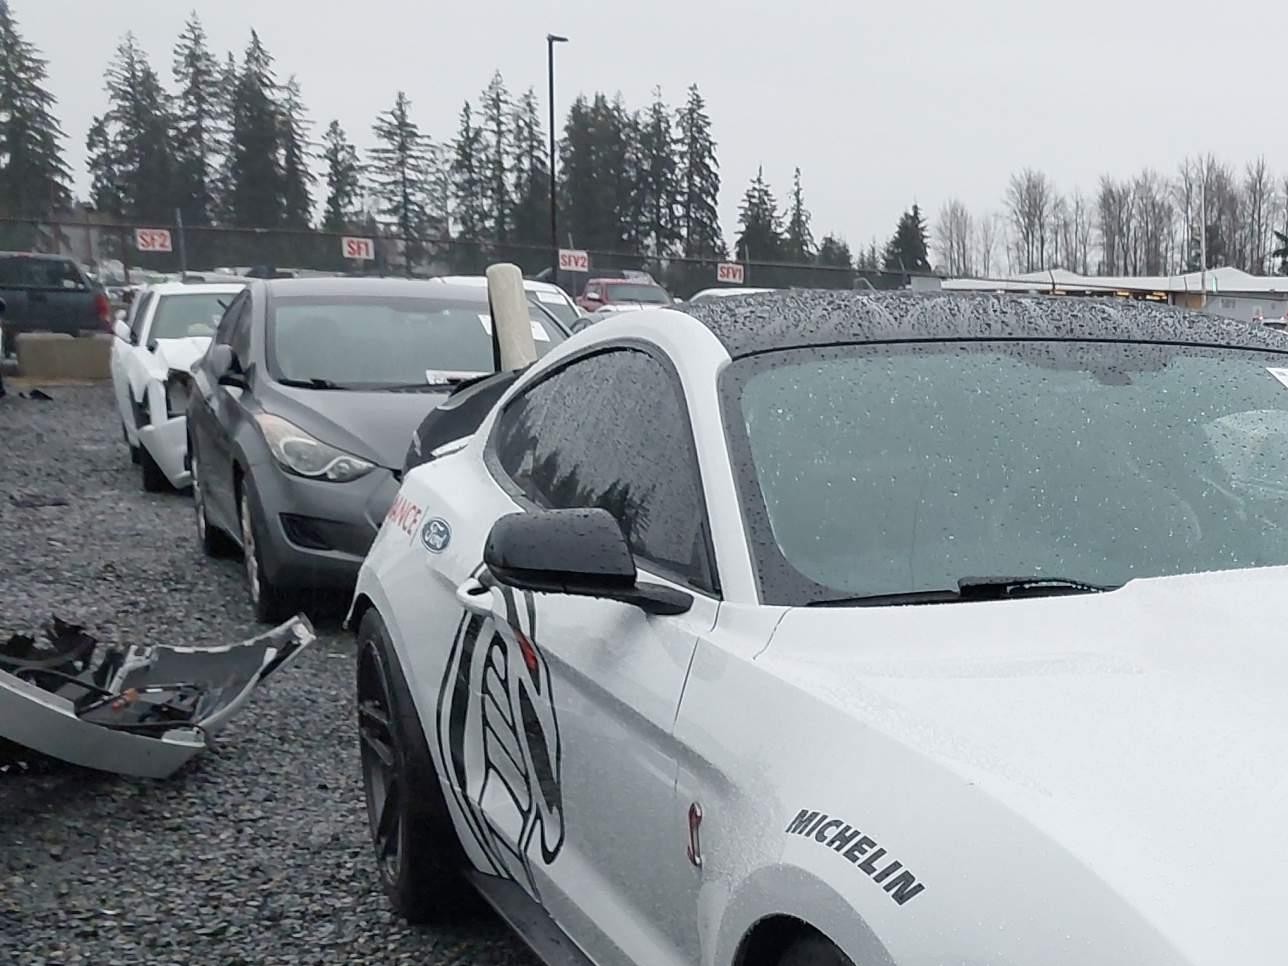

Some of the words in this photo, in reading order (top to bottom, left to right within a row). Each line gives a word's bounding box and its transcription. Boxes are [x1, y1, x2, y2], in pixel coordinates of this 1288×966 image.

[139, 231, 170, 249] SF2
[347, 240, 370, 257] SF1
[560, 254, 587, 268] SFV2
[719, 266, 742, 281] SFV1
[424, 520, 449, 550] Ford
[785, 809, 926, 906] MICHELIN
